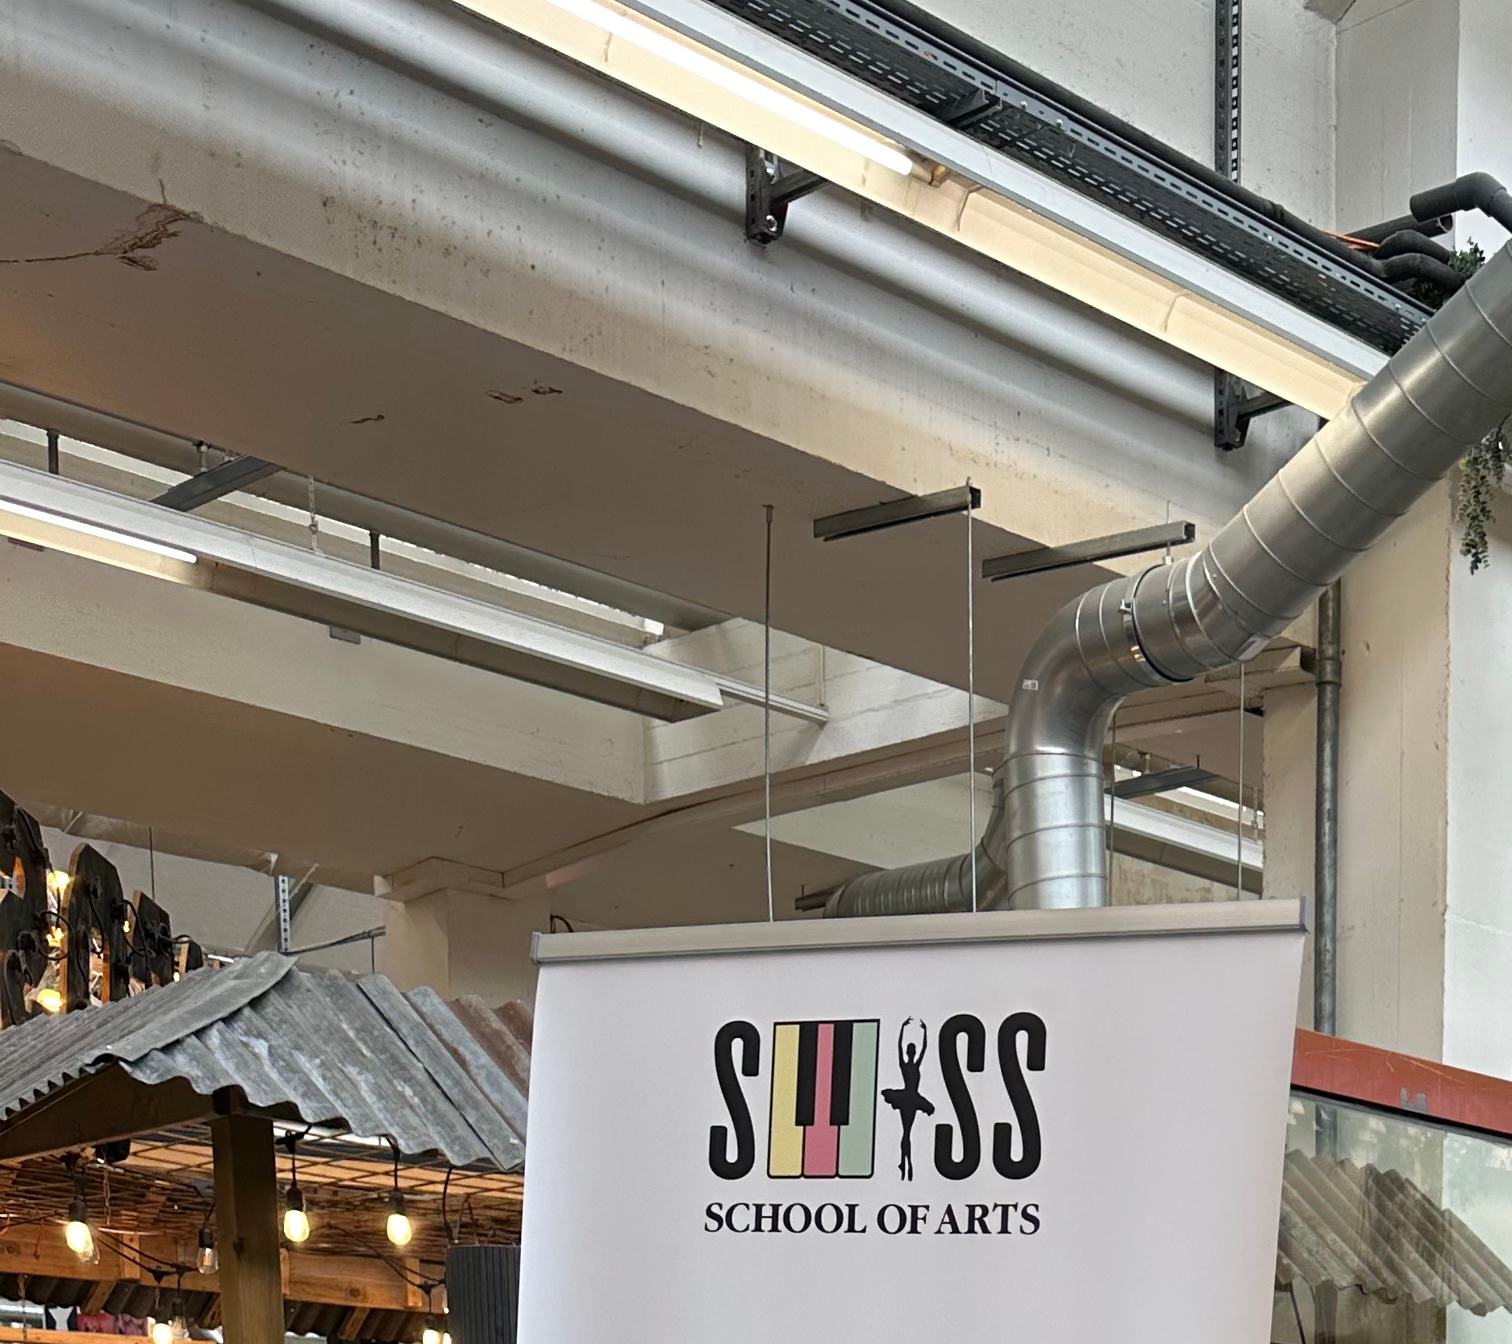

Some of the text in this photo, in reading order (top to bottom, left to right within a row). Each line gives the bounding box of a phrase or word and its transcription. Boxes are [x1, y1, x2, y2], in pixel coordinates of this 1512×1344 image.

[703, 1201, 1041, 1236] SCHOOL OF ARTS
